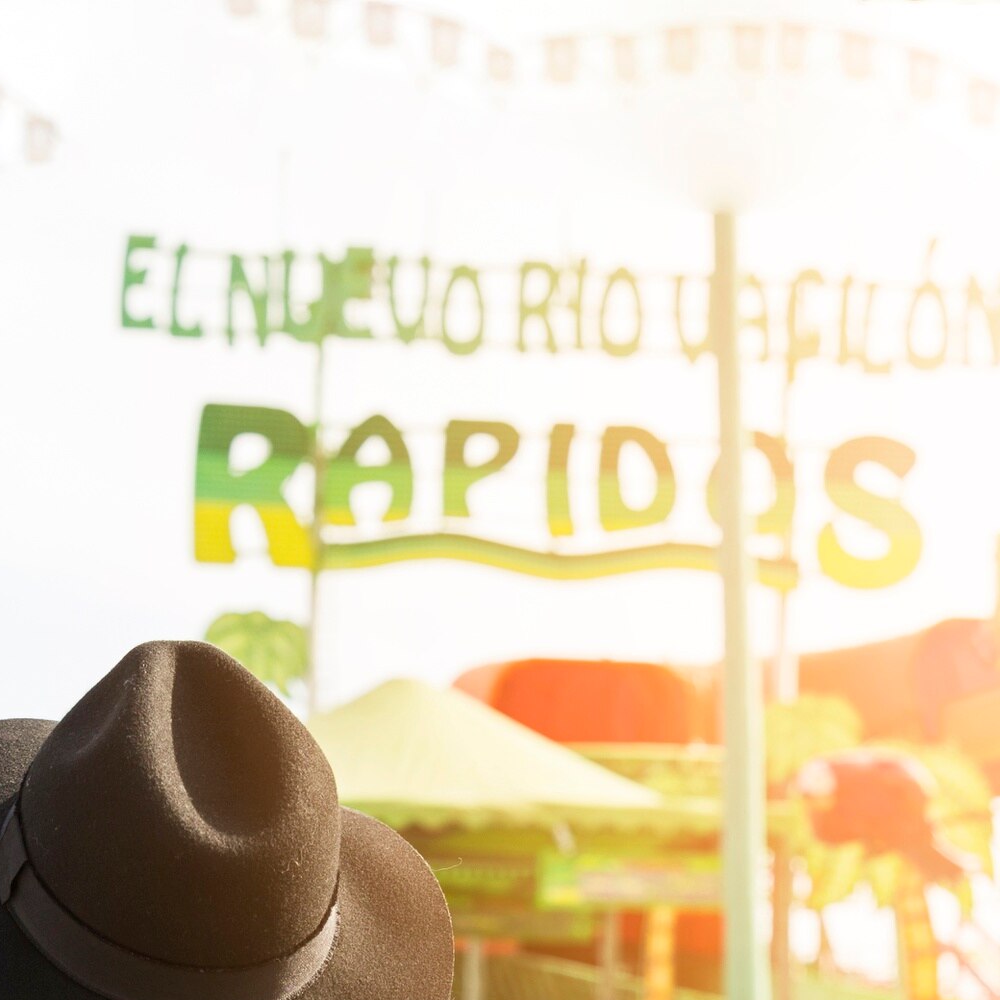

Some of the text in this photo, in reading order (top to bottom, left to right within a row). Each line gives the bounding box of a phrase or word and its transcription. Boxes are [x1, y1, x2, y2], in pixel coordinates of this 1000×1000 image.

[121, 235, 203, 338] EL
[226, 247, 486, 356] NUEVO
[516, 258, 643, 357] RIO
[194, 403, 923, 590] RAPIDOS
